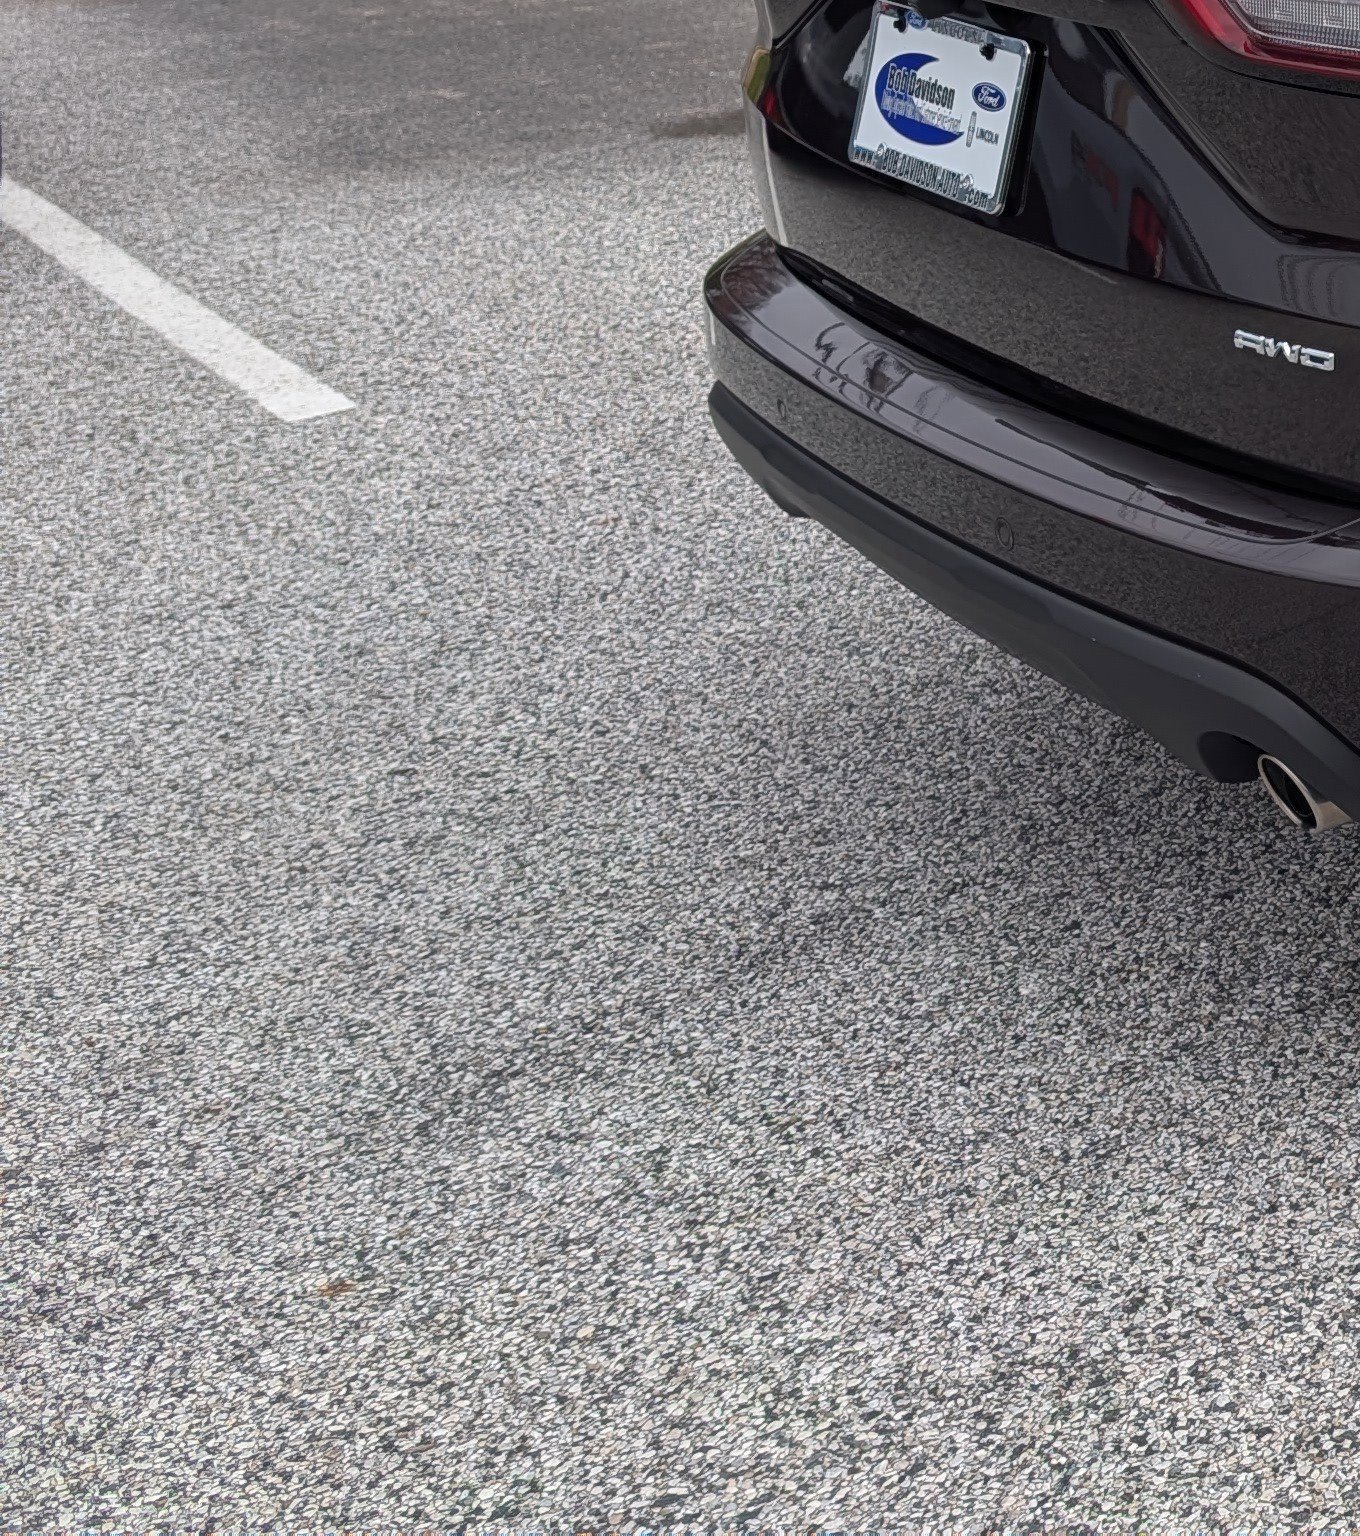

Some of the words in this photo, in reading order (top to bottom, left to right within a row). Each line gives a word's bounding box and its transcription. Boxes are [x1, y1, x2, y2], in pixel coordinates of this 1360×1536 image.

[887, 64, 908, 94] Bob
[908, 71, 956, 110] Davidson
[977, 86, 1000, 109] Ford
[975, 126, 999, 146] LINCOLN
[1233, 329, 1335, 371] AWD
